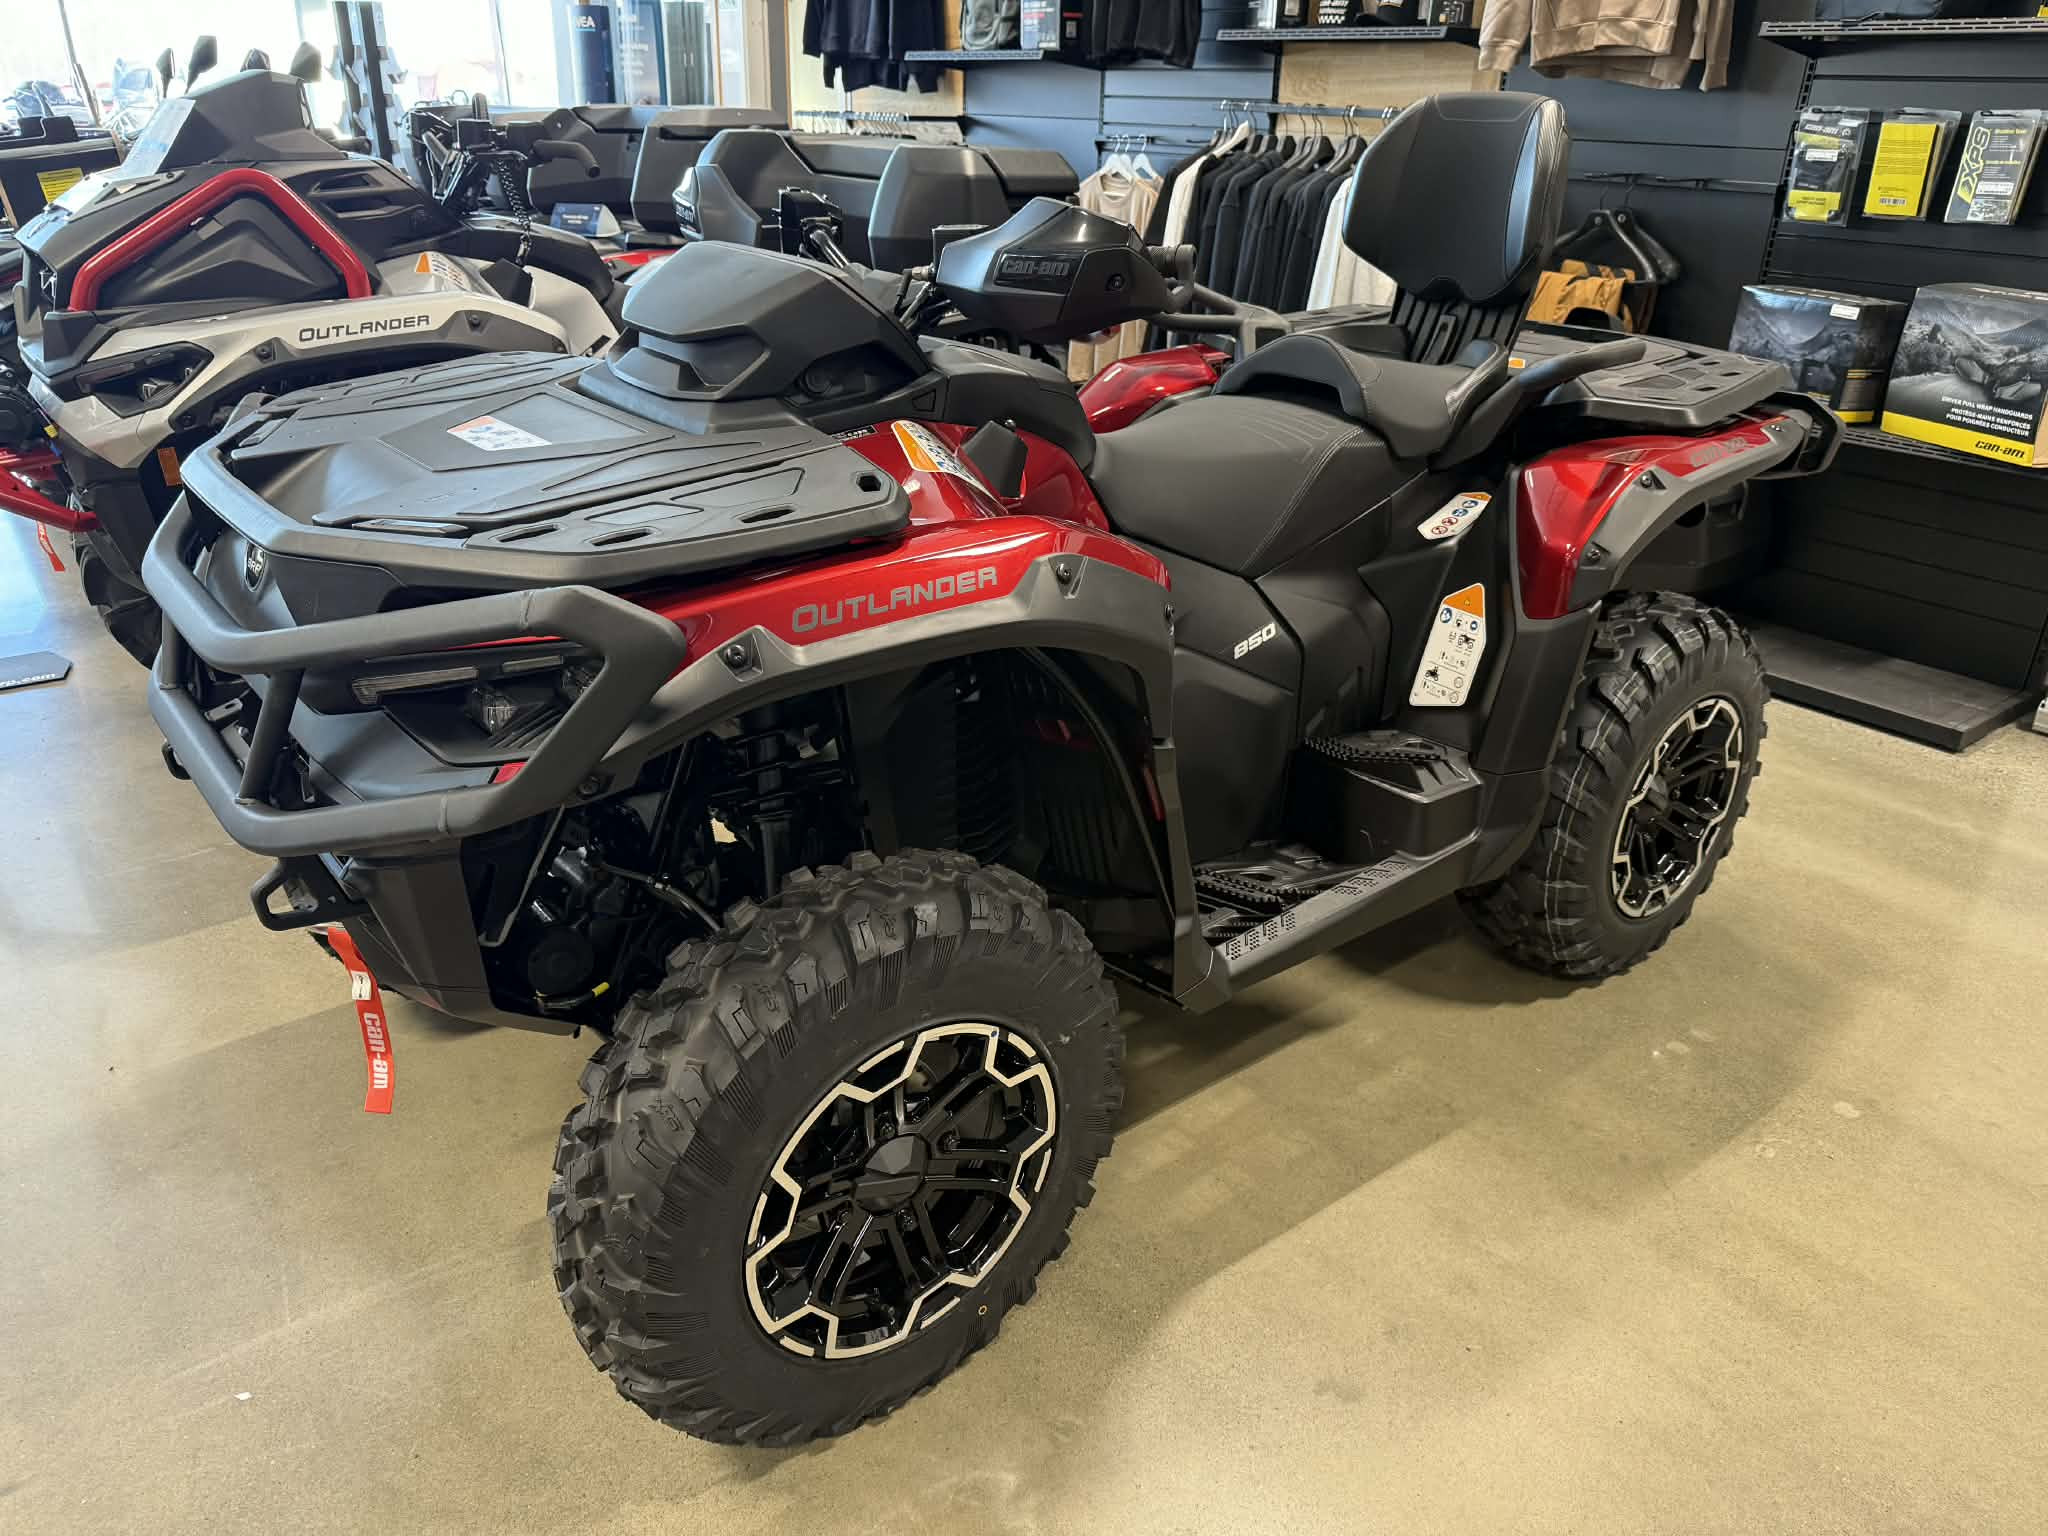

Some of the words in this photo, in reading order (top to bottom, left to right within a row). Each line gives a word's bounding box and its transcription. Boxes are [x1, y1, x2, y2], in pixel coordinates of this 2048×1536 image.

[1001, 260, 1070, 276] can-am
[299, 315, 430, 342] OUTLANDER
[1976, 403, 1993, 412] WRAP
[1975, 440, 2026, 459] can-am
[792, 566, 998, 633] OUTLANDER
[1233, 622, 1276, 660] 850
[363, 1012, 389, 1089] can-am
